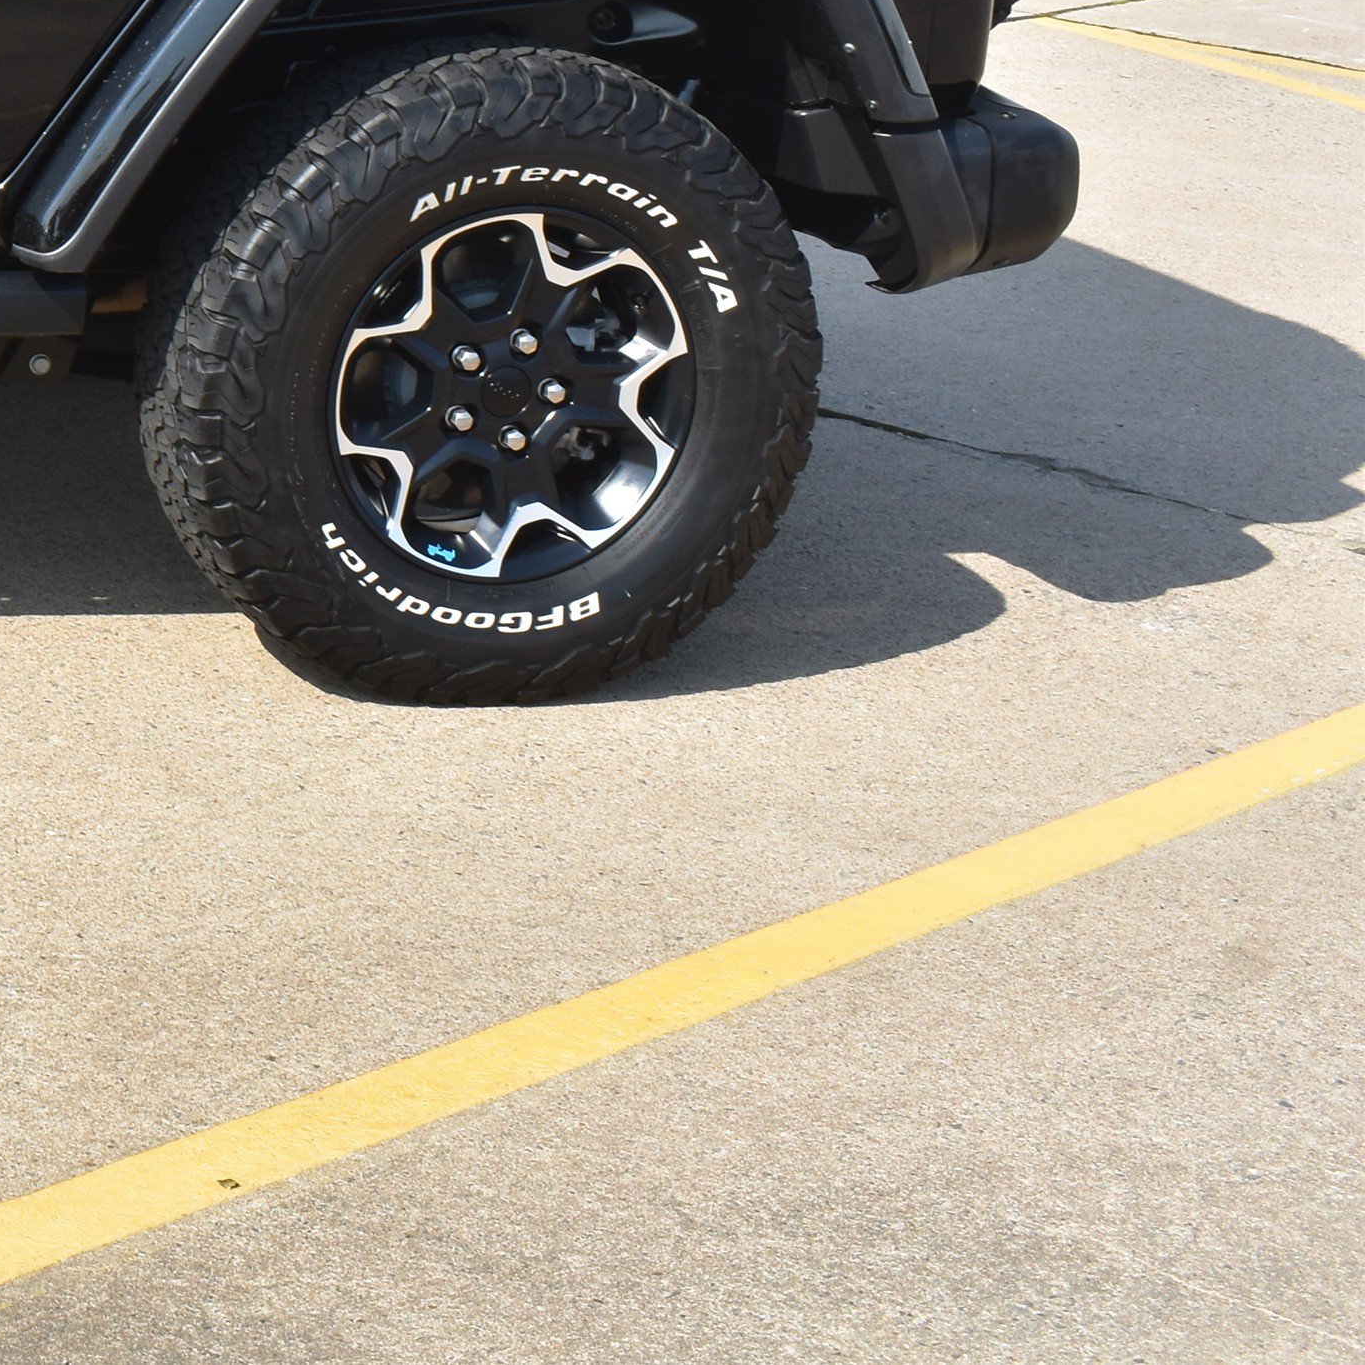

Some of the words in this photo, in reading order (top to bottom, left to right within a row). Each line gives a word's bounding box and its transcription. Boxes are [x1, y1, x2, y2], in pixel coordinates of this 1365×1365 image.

[409, 164, 678, 229] All-Terrain
[686, 238, 738, 314] T/A
[320, 521, 601, 634] BFGoodrich
